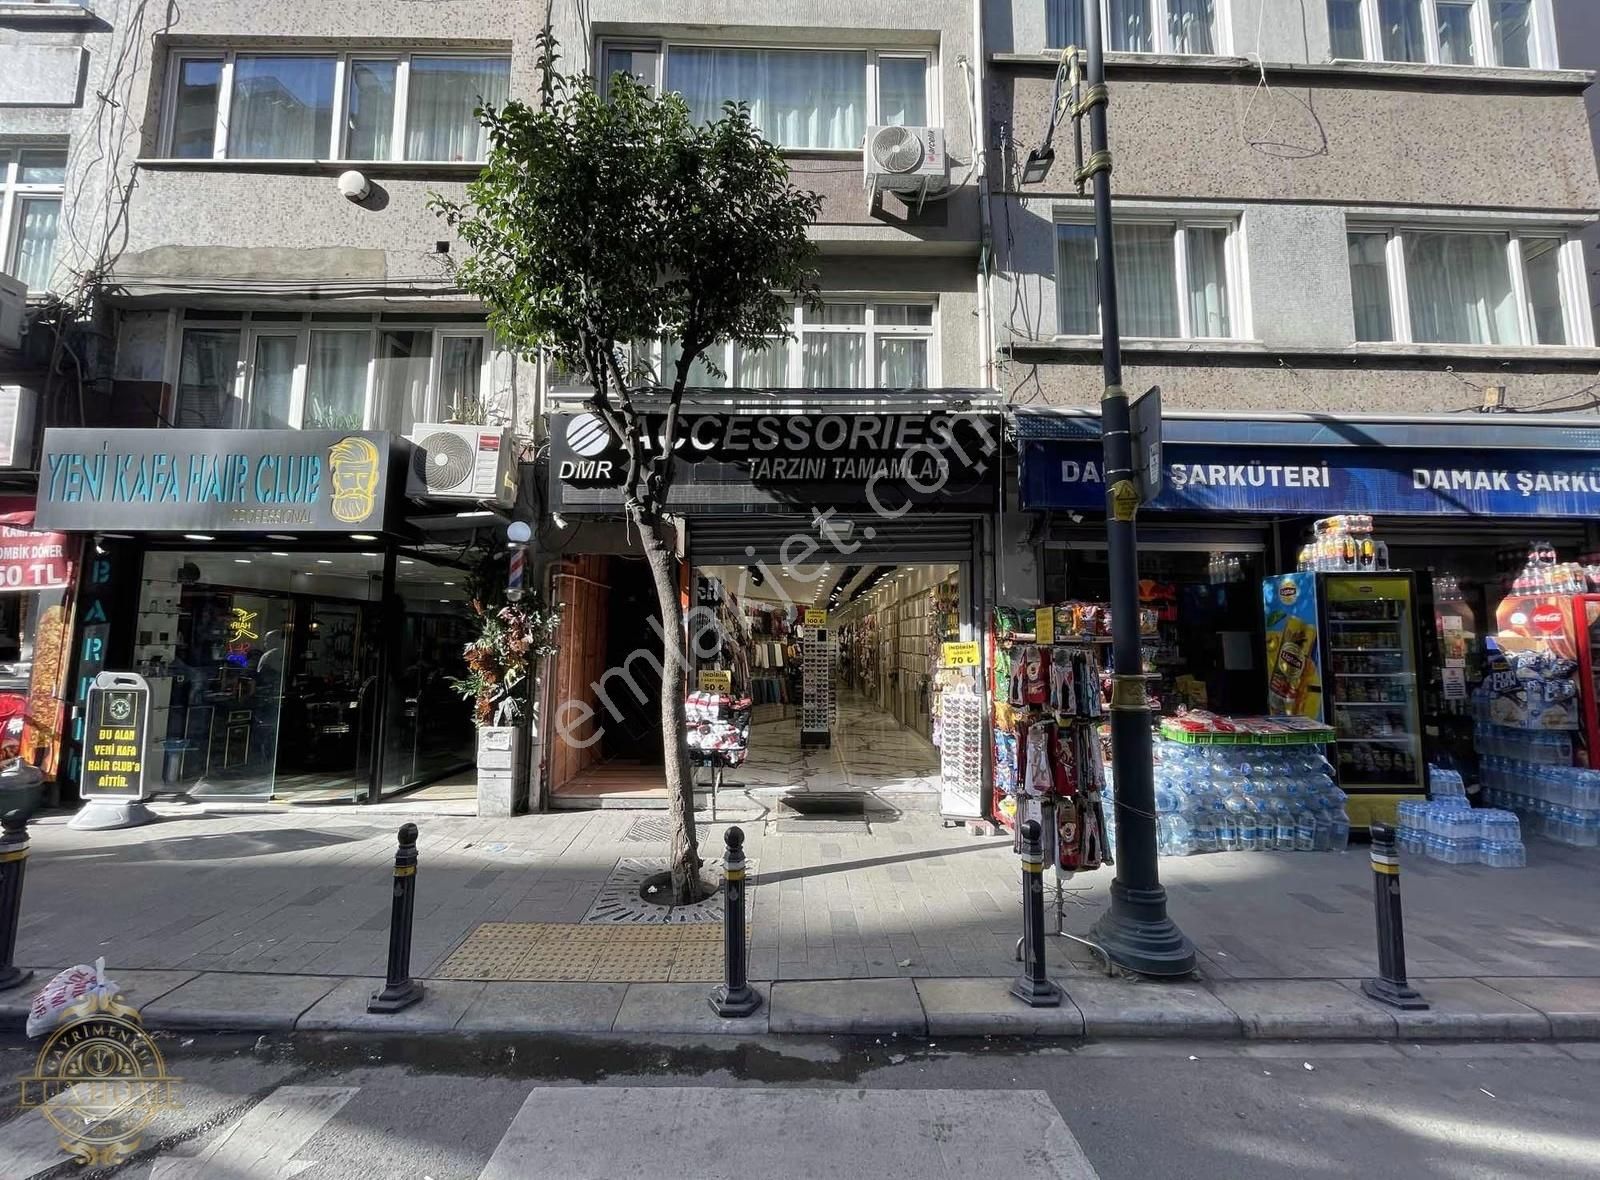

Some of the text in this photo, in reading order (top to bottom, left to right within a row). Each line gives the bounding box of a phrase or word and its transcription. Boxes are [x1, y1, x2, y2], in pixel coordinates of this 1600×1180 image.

[48, 440, 321, 504] YENİ KAFA HAIR CLUB
[559, 459, 613, 480] DMR
[747, 457, 951, 480] TARZINI TAMAMLAR
[1170, 460, 1330, 490] ŞARKÜTERİ
[1412, 468, 1511, 491] DAMAK
[30, 563, 62, 585] TL
[951, 656, 964, 664] 70
[704, 683, 716, 691] 50
[99, 729, 135, 740] BU ALAN
[94, 743, 115, 756] YENİ
